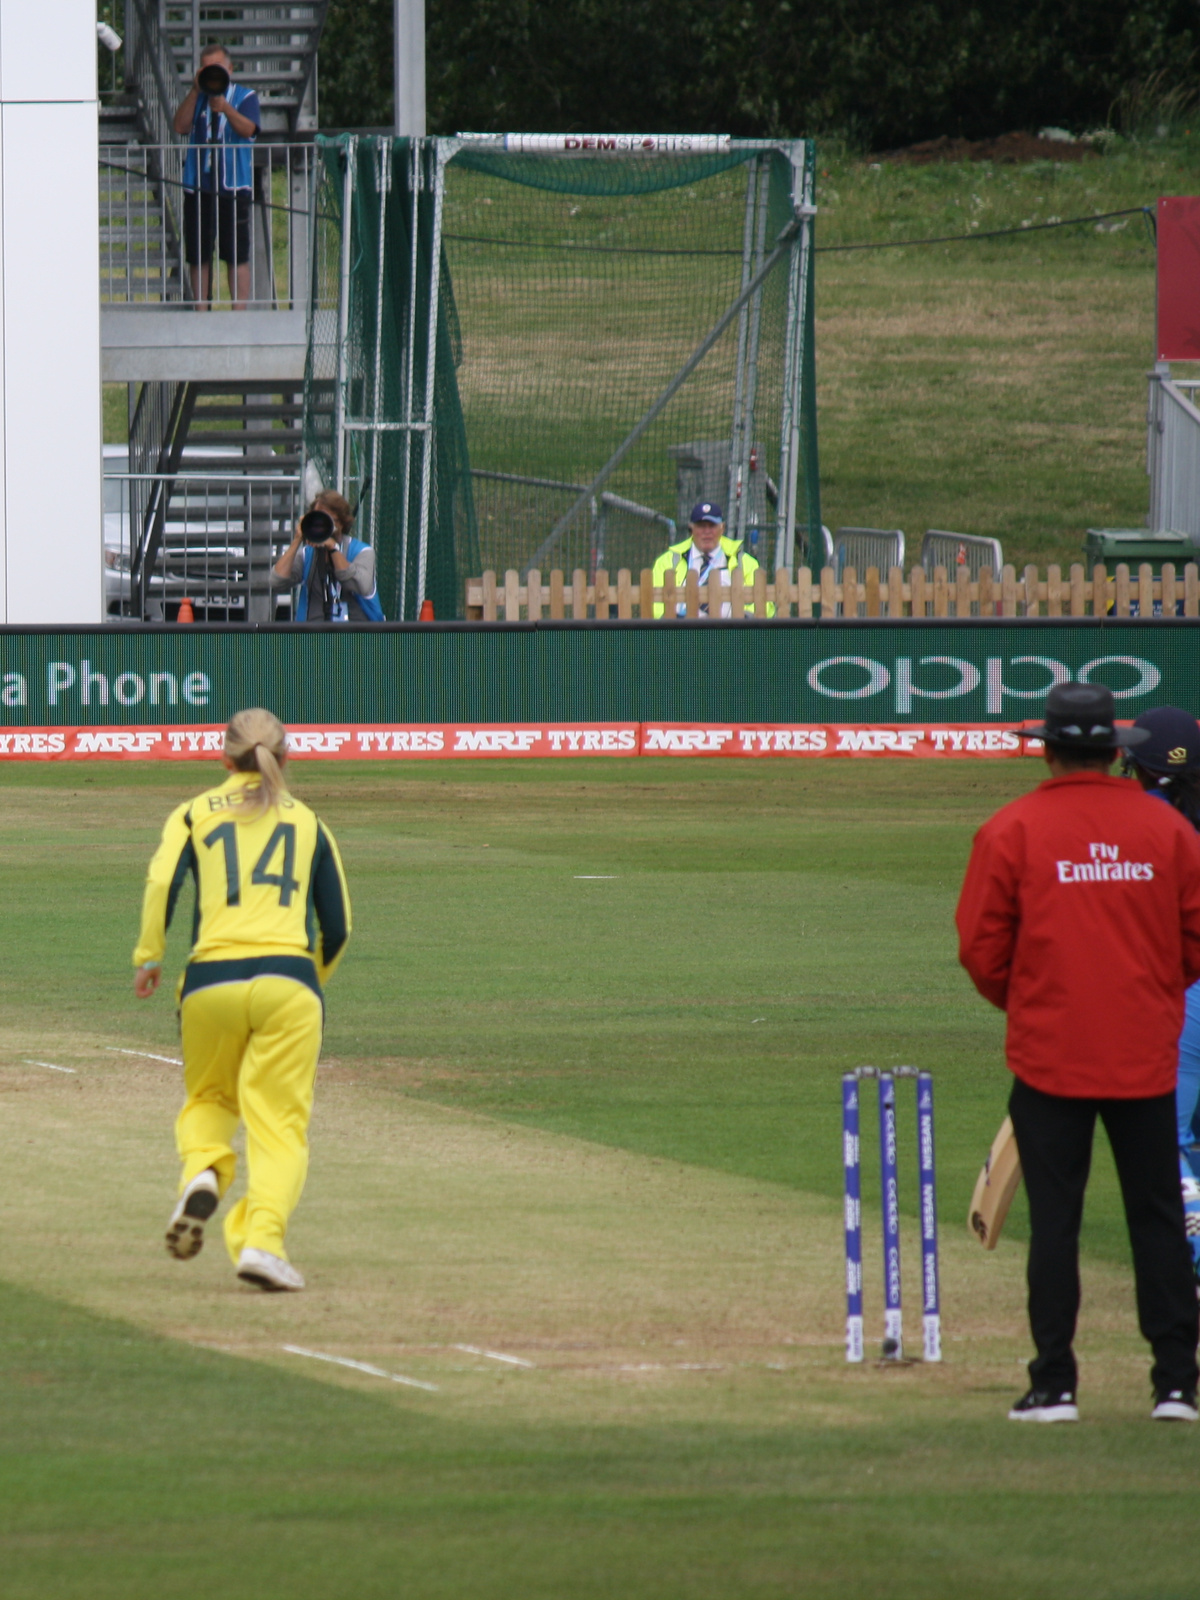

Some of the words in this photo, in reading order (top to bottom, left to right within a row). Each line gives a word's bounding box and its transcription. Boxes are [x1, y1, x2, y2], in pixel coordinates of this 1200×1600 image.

[564, 137, 691, 150] DEMSPORTS
[48, 660, 211, 706] Phone
[807, 655, 1161, 714] oppo
[74, 732, 161, 752] MRF
[168, 731, 227, 751] TYR
[357, 731, 444, 751] TYRES
[454, 730, 541, 751] MRF
[548, 730, 635, 750] TYRES
[645, 730, 732, 751] MRF
[739, 730, 827, 751] TYRES
[837, 730, 924, 751] MRF
[931, 730, 1020, 750] TYRES
[1089, 843, 1119, 861] Fly
[202, 821, 299, 907] 14
[1056, 859, 1154, 883] Emirates
[921, 1115, 932, 1170] NISSAN
[923, 1184, 934, 1239] NISSAN
[925, 1253, 936, 1310] NISSAN
